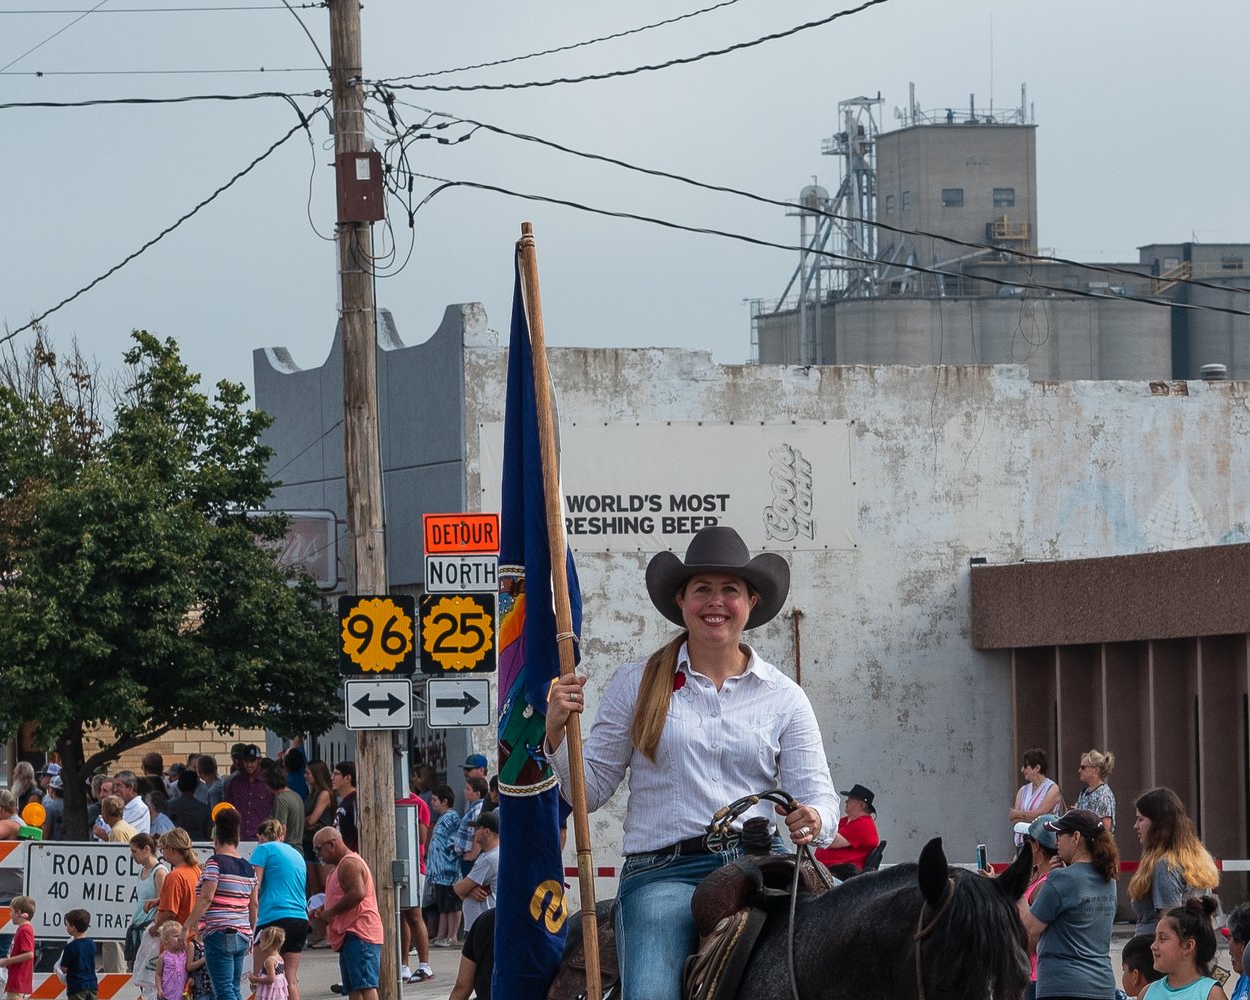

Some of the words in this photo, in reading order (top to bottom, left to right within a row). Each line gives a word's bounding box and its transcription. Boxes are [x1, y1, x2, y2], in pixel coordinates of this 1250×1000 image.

[566, 494, 662, 512] WORLD'S
[670, 494, 730, 512] MOST
[432, 523, 493, 545] DETOUR
[565, 516, 655, 535] RESHING
[430, 561, 496, 585] NORTH
[347, 614, 407, 656] 96
[432, 612, 485, 654] 25
[52, 854, 109, 876] ROAD
[115, 854, 139, 876] CL
[48, 881, 69, 900] 40
[82, 883, 125, 902] MILE
[96, 913, 133, 928] TRAF
